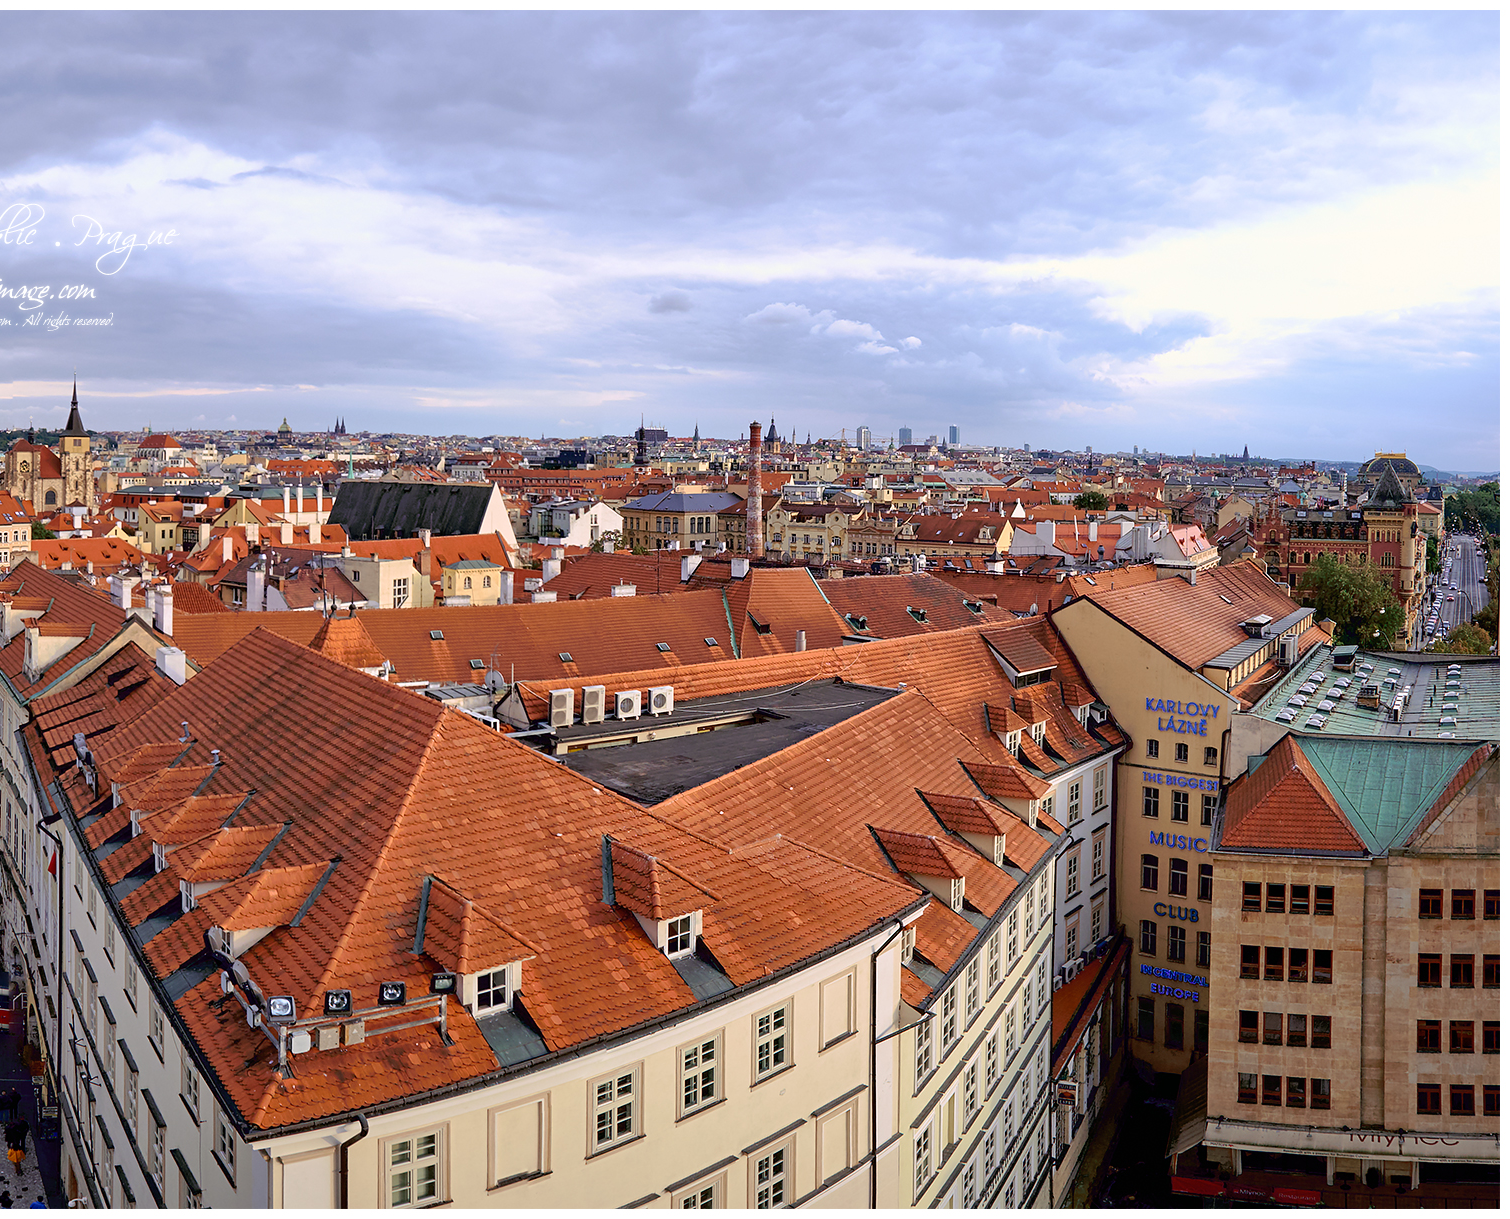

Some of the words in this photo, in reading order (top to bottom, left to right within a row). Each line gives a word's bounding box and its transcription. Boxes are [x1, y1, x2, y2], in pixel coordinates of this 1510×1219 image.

[1145, 697, 1220, 719] KARLOVY
[1157, 715, 1208, 736] LÁZNĚ
[1142, 771, 1164, 785] THE
[1165, 774, 1219, 791] BIGGEST
[1149, 830, 1208, 852] MUSIC
[1153, 902, 1199, 922] CLUB
[1140, 963, 1153, 975] IN
[1153, 966, 1209, 987] CENTRAL
[1150, 982, 1199, 1002] EUROPE
